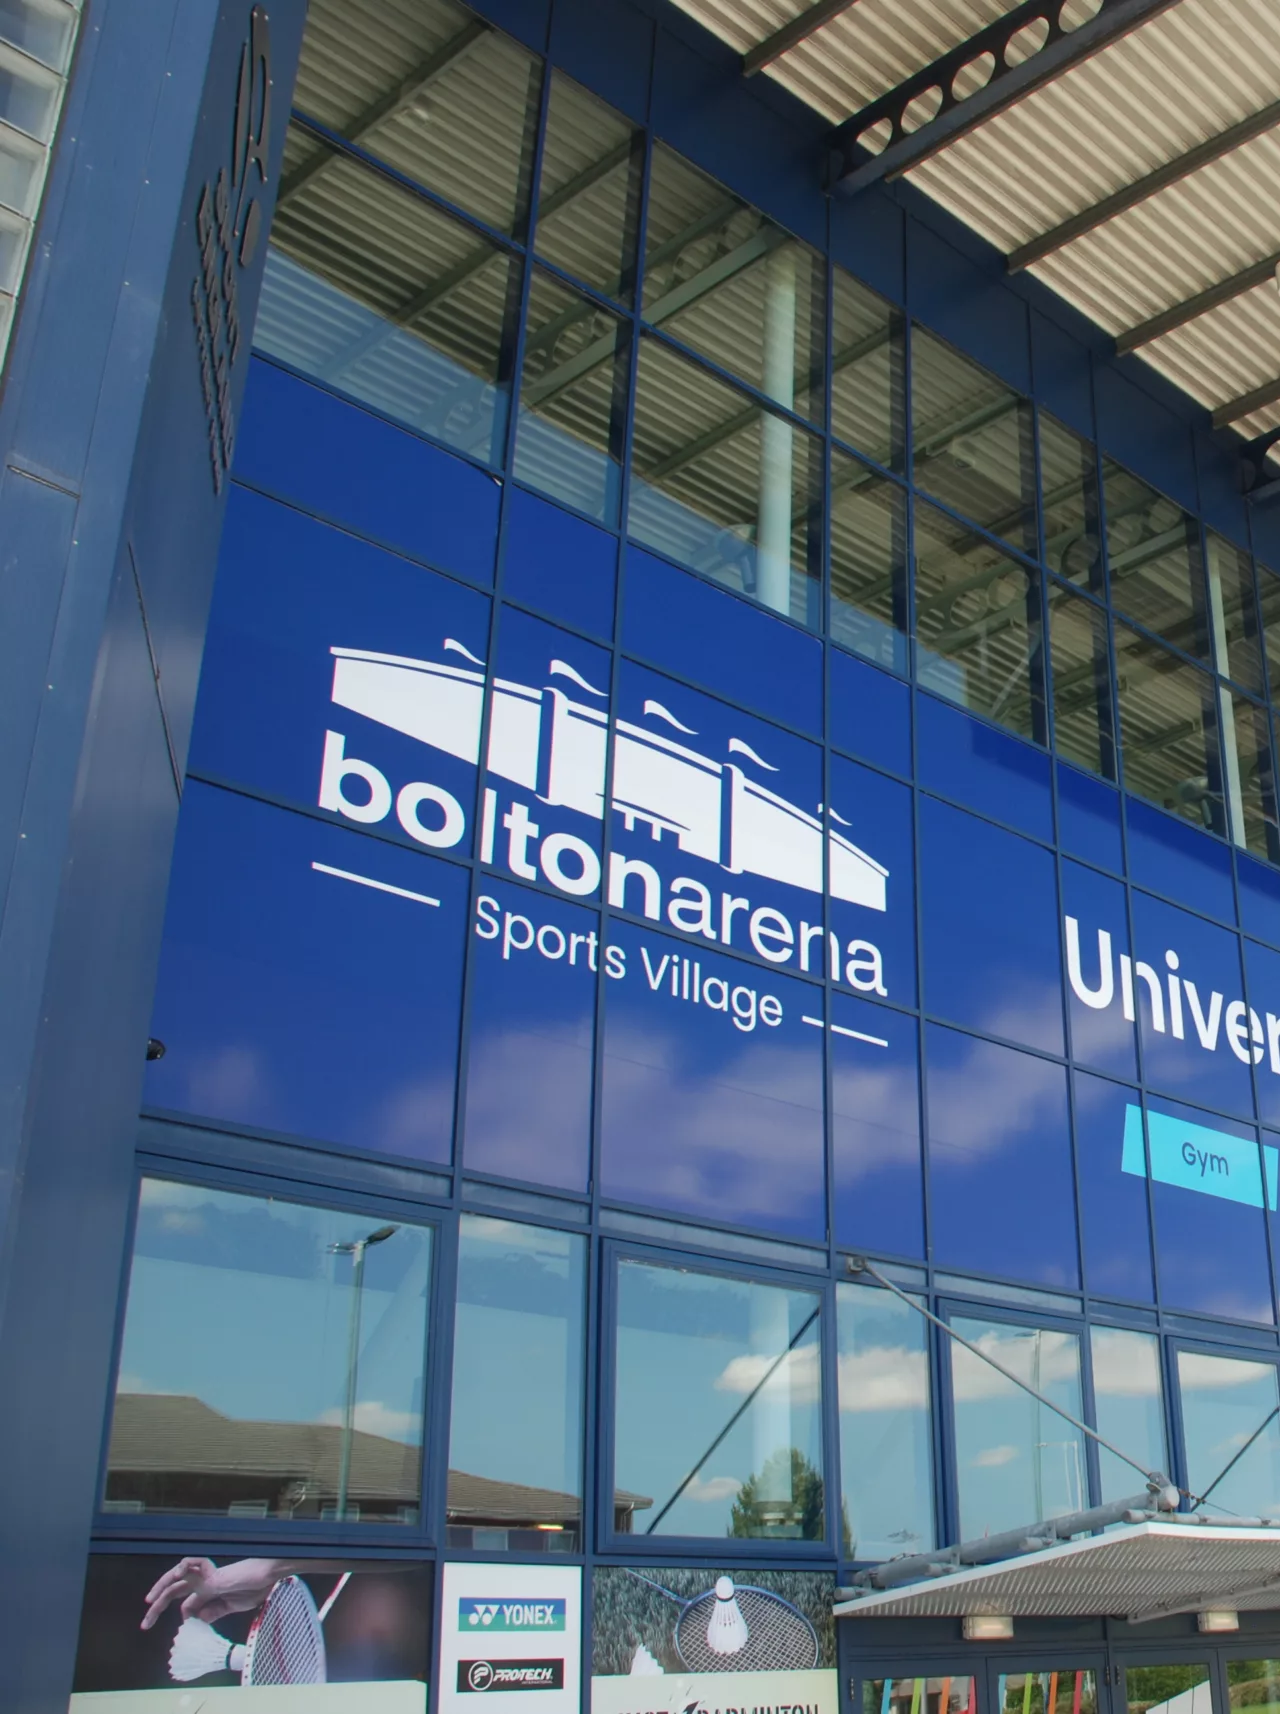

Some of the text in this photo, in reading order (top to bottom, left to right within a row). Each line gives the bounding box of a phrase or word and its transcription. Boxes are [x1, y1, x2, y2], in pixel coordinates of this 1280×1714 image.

[318, 728, 888, 998] boltonarena
[475, 894, 784, 1033] Sports Village
[1181, 1141, 1230, 1178] Gym
[502, 1604, 555, 1625] YONEX
[696, 1703, 819, 1714] INTON
